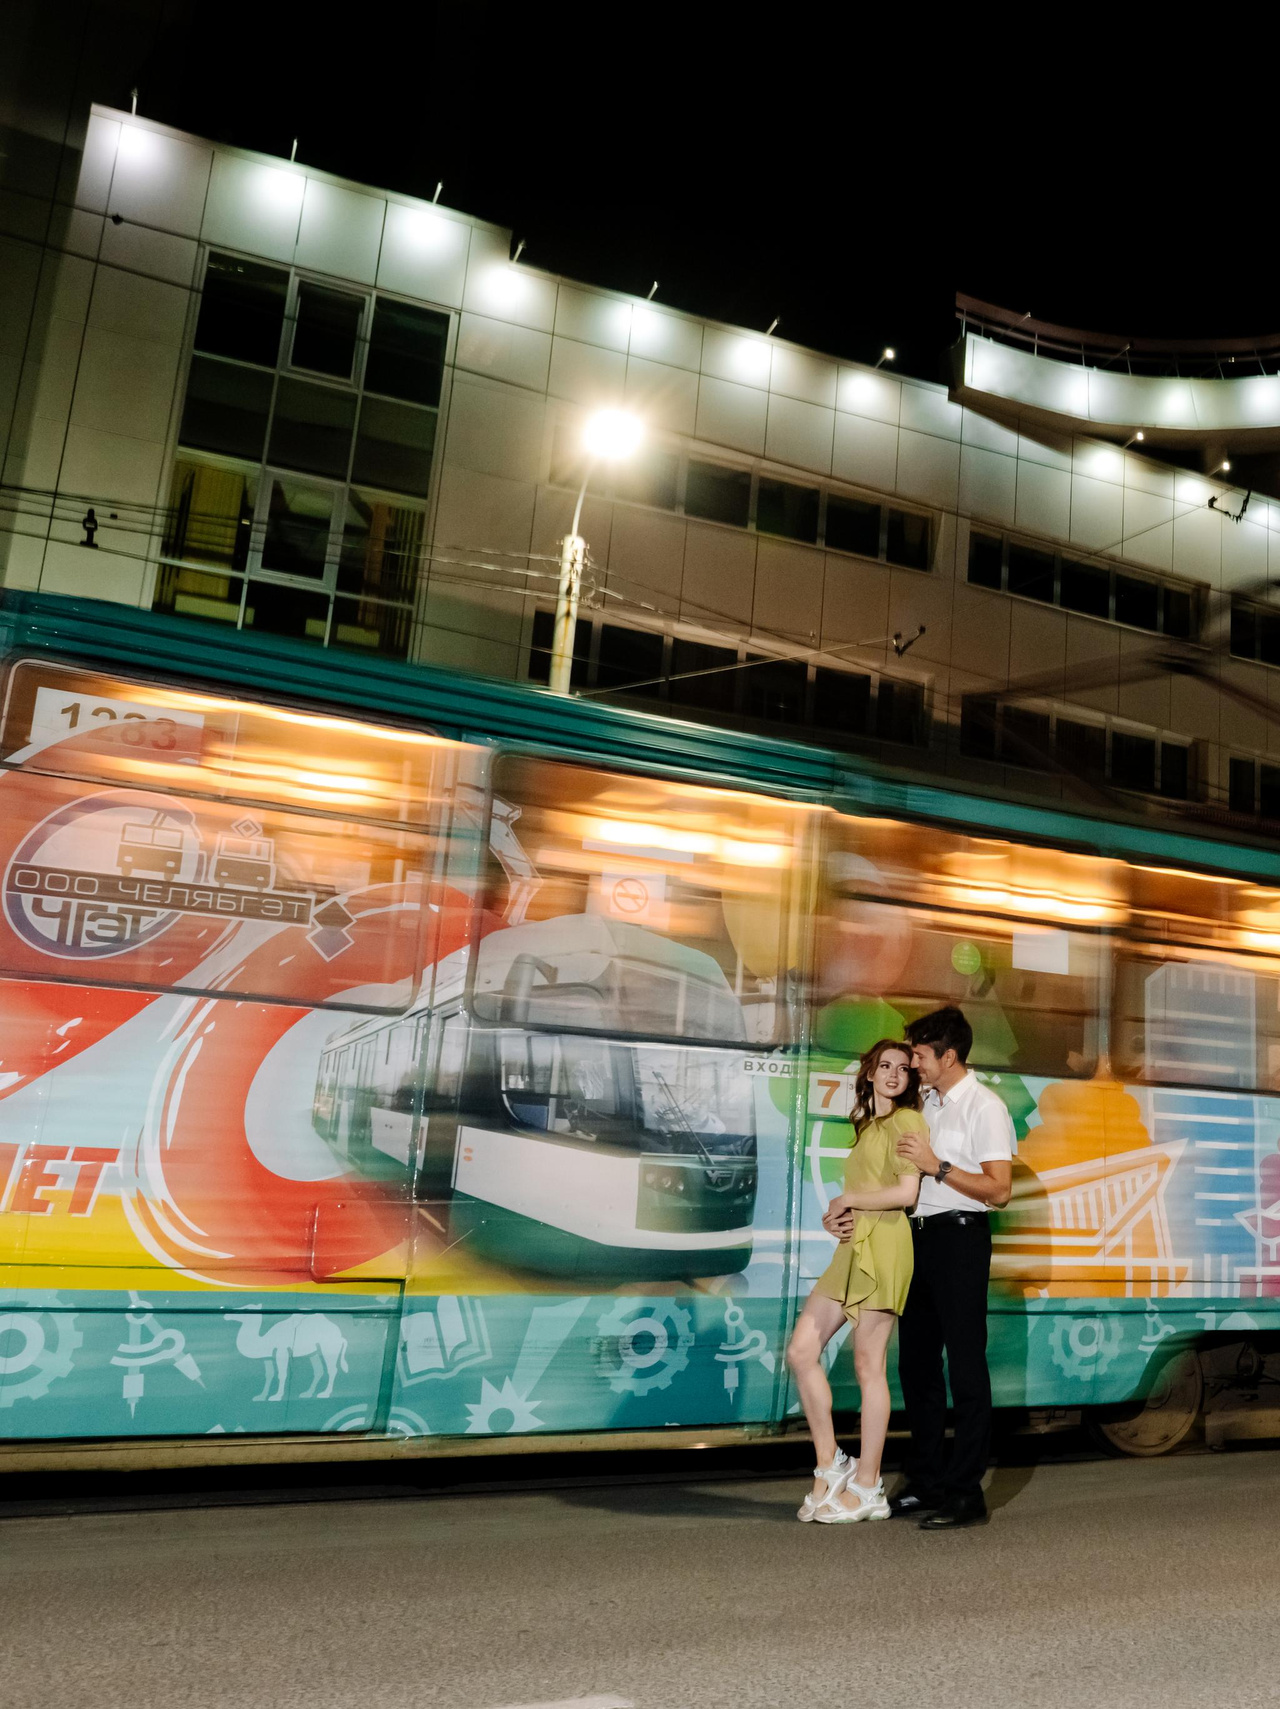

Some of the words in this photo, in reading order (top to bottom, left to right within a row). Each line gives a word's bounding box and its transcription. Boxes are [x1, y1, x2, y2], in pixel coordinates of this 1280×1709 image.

[14, 869, 99, 896] ООО
[117, 880, 308, 920] ЧЕЛЯБГЭТ
[743, 1060, 792, 1076] ВХОД
[817, 1079, 841, 1109] 7
